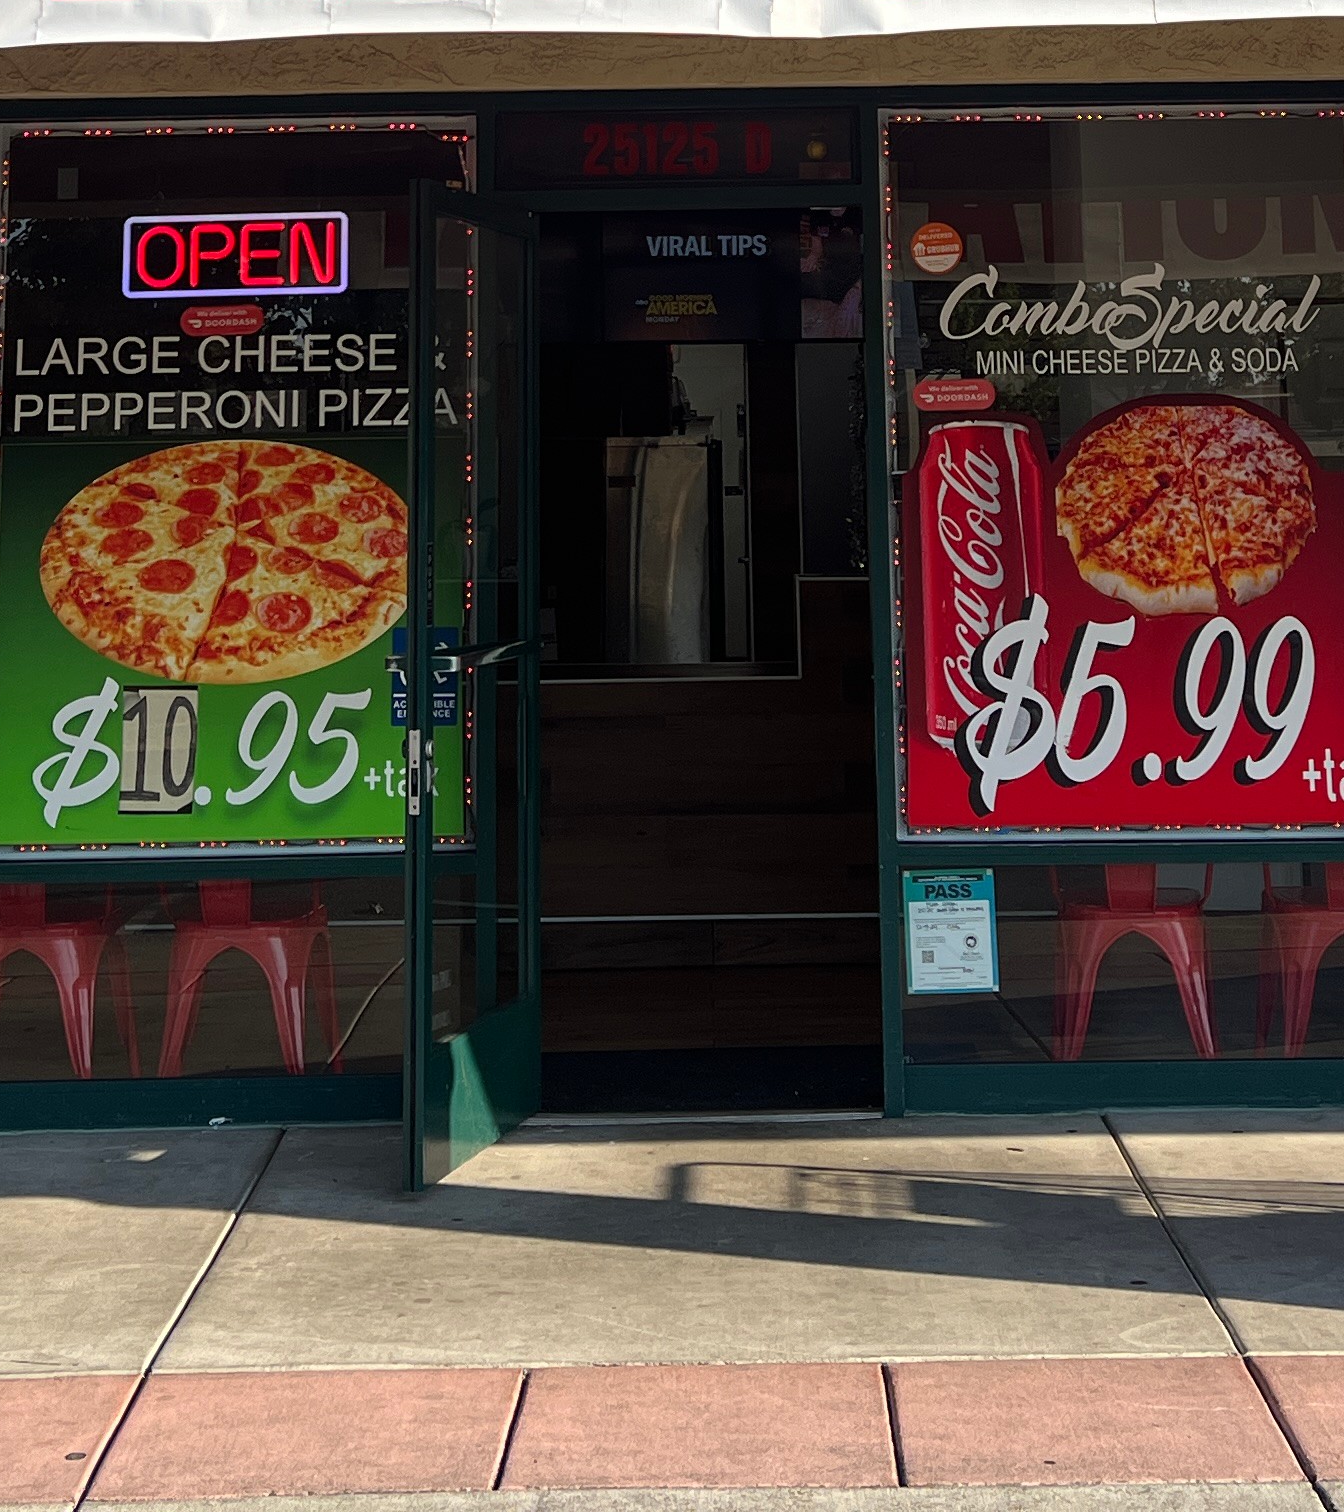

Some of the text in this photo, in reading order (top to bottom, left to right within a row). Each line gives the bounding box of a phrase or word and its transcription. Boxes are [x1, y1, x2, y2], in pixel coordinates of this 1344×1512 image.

[582, 120, 773, 178] 25125 D
[135, 219, 337, 289] OPEN
[645, 234, 768, 257] VIRAL TIPS
[645, 300, 718, 316] AMERICA
[939, 262, 1322, 351] Combo Special
[14, 335, 180, 377] LARGE
[196, 332, 398, 374] CHEESE
[975, 346, 1300, 376] MINI CHEESE PIZZA & SODA
[13, 390, 301, 433] PEPPERONI
[936, 393, 989, 403] DOORDASH
[392, 699, 456, 709] ACIBLE
[32, 676, 373, 828] $10.95
[924, 883, 973, 899] PASS
